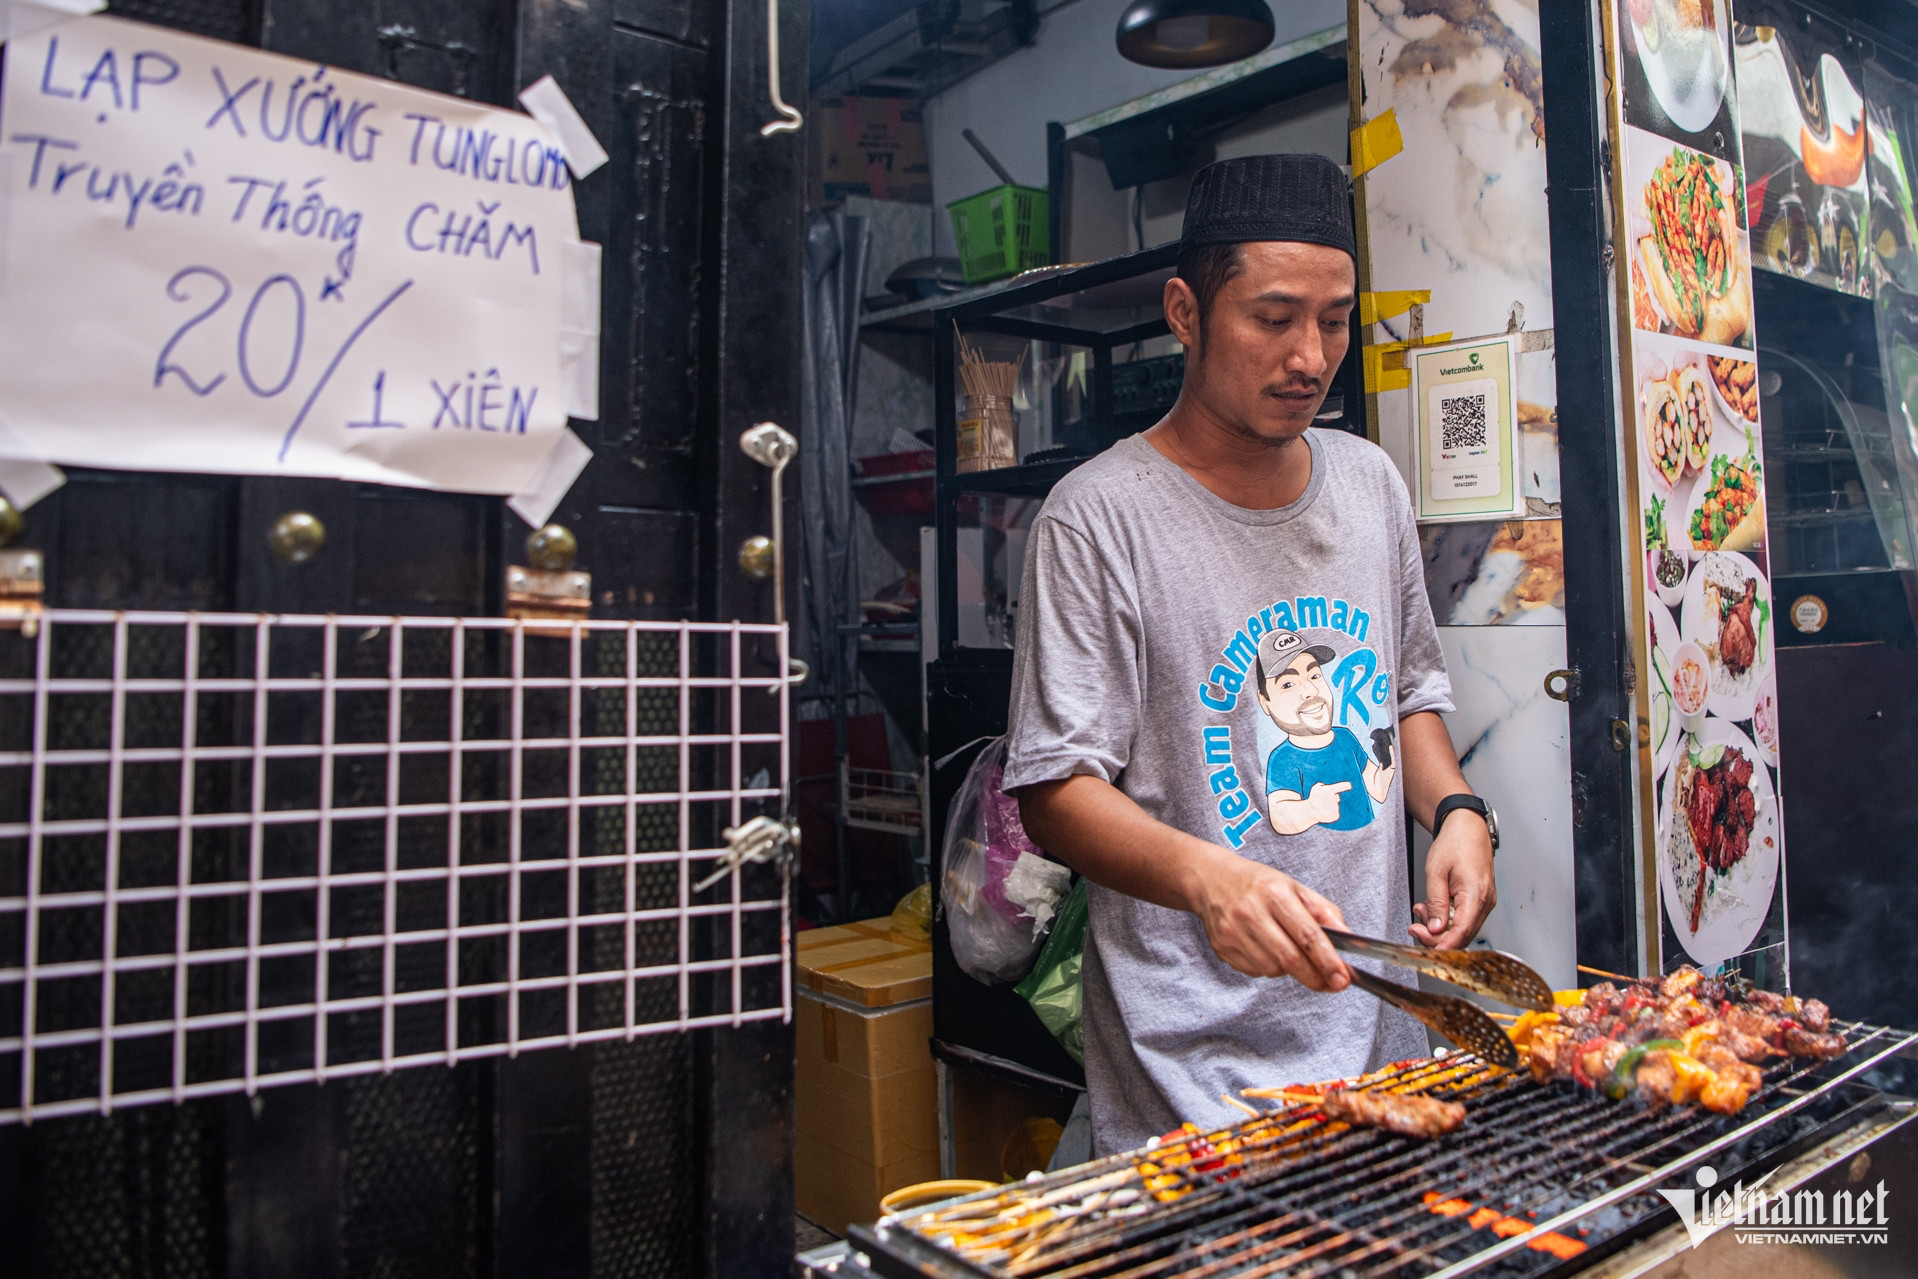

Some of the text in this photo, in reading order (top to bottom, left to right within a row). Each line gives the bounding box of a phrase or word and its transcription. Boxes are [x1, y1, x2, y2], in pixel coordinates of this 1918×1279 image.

[41, 36, 180, 122] LẠP
[10, 133, 540, 281] Truyền Thống CHĂM
[346, 371, 405, 428] 1
[1440, 364, 1484, 376] Vietcombank
[1198, 595, 1371, 713] Cameraman
[1278, 636, 1296, 648] CMR
[1203, 725, 1264, 850] Team
